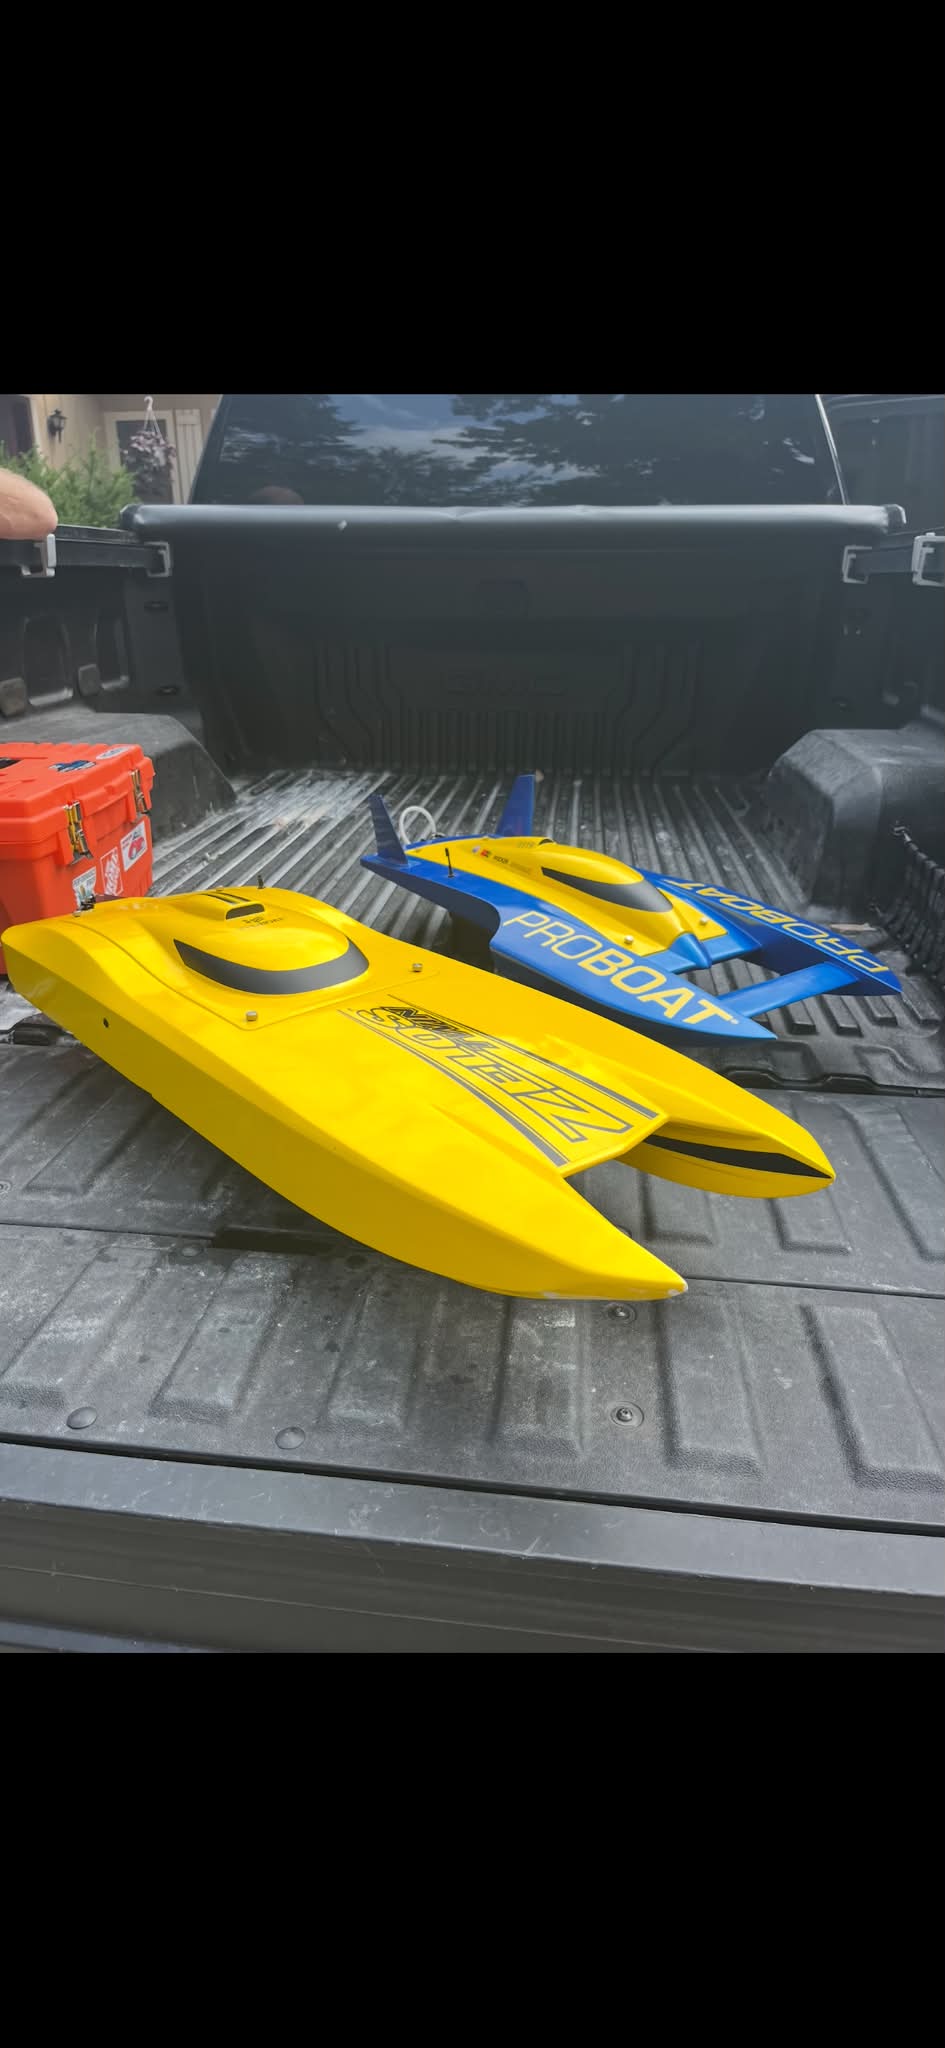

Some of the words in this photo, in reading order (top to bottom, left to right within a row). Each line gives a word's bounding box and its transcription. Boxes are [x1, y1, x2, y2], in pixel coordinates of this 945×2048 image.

[503, 910, 735, 1024] PROBOAT
[664, 879, 889, 972] PROBOAT
[356, 1007, 634, 1142] ZELOS
